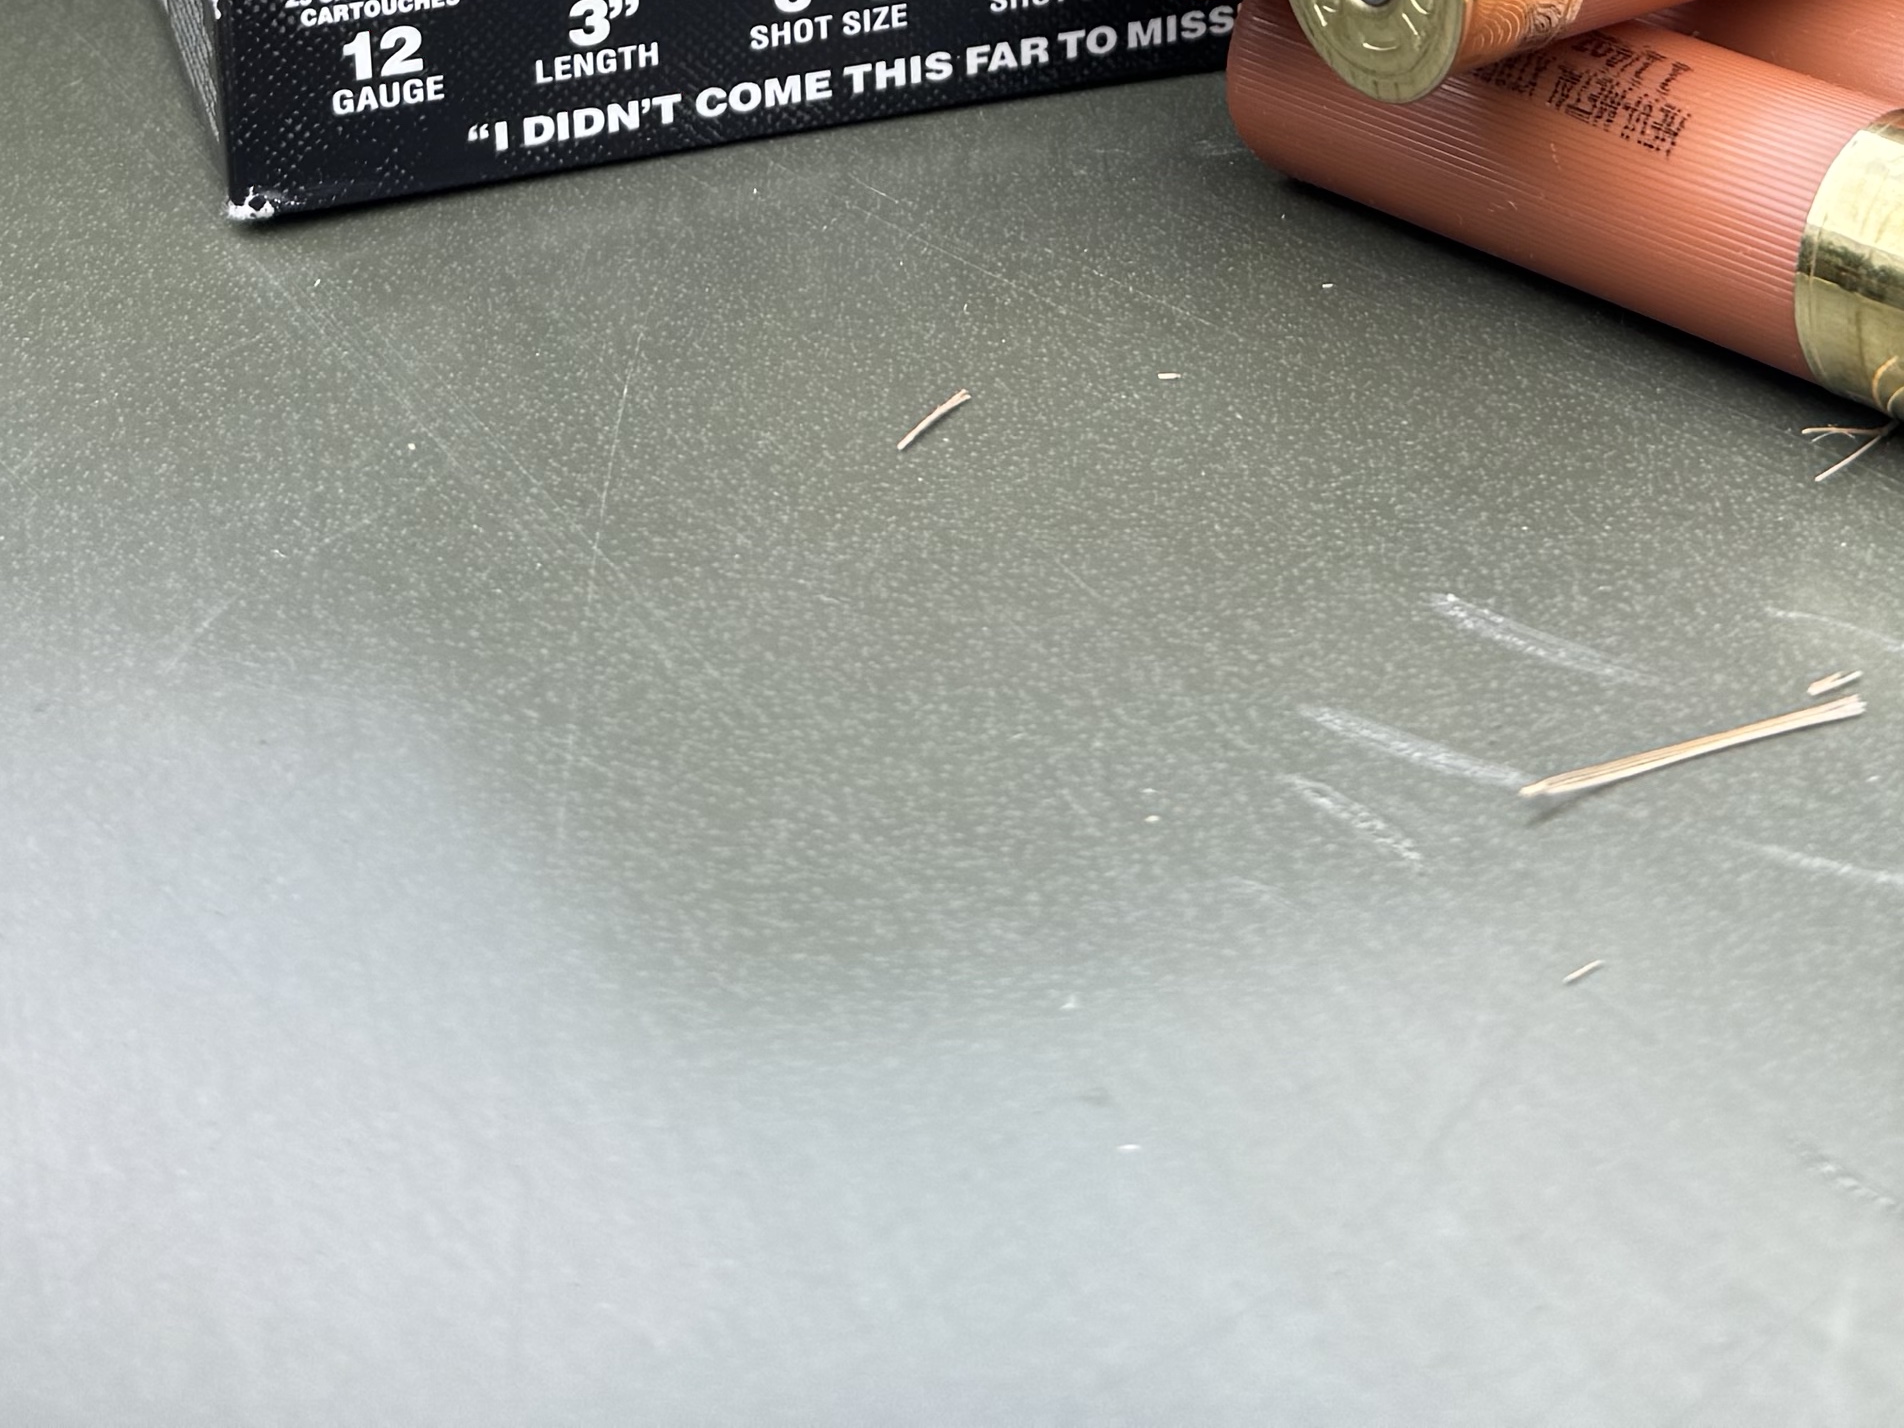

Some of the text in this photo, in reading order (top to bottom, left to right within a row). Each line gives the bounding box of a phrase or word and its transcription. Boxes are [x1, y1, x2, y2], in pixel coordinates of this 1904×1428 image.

[750, 4, 909, 50] SHOT SIZE
[342, 25, 425, 82] 12
[535, 42, 660, 85] LENGTH
[695, 70, 834, 119] COME
[844, 51, 955, 96] THIS
[965, 36, 1050, 79] FAR
[1058, 24, 1118, 61] TO
[1127, 4, 1242, 49] MISS
[332, 75, 446, 116] GAUGE
